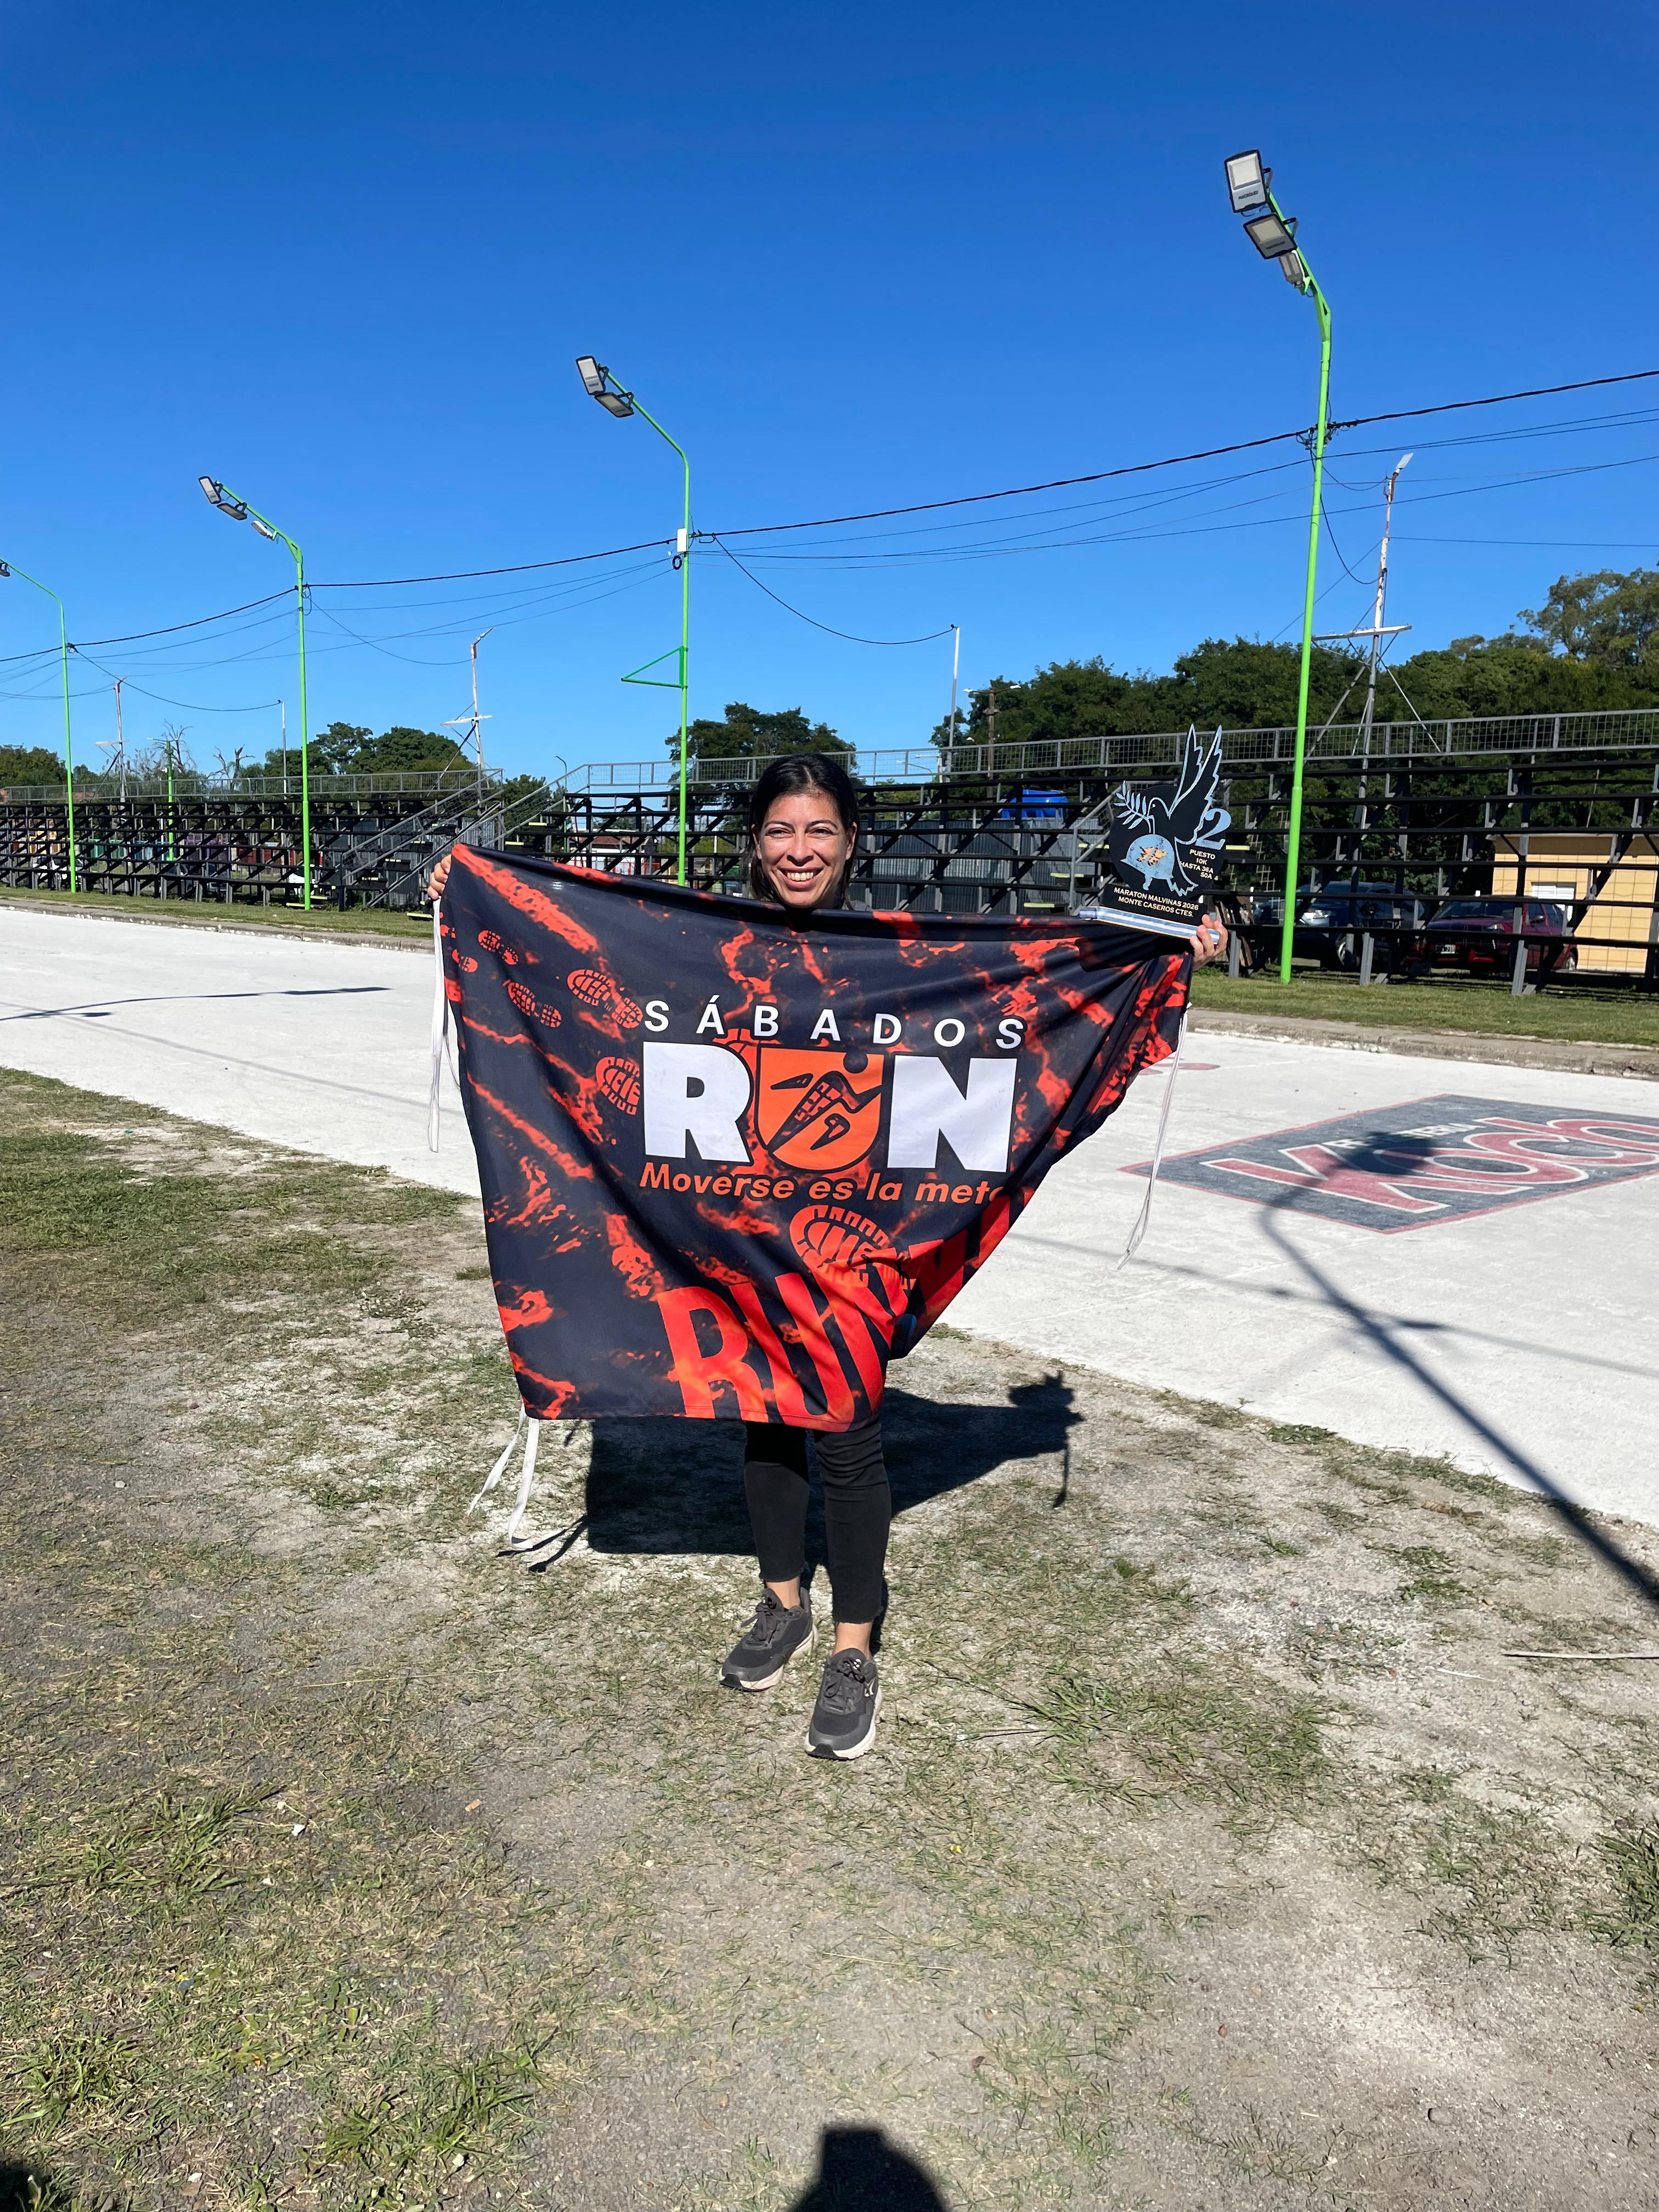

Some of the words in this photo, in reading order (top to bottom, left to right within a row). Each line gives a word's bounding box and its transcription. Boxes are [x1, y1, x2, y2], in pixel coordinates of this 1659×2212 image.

[1195, 808, 1231, 850] 2
[1180, 861, 1201, 871] HASTA
[1189, 849, 1216, 860] PUESTO
[1114, 887, 1147, 900] MARATON
[1148, 895, 1182, 907] MALVINAS
[1182, 902, 1199, 911] 2026
[1118, 896, 1143, 906] MONTE
[1143, 901, 1175, 913] CASEROS
[1175, 909, 1194, 917] CTES.
[644, 995, 1026, 1049] SÁBADOS
[1200, 1116, 1659, 1214] Koch
[640, 1163, 794, 1199] Moverse
[809, 1181, 853, 1200] es
[867, 1173, 902, 1201] la
